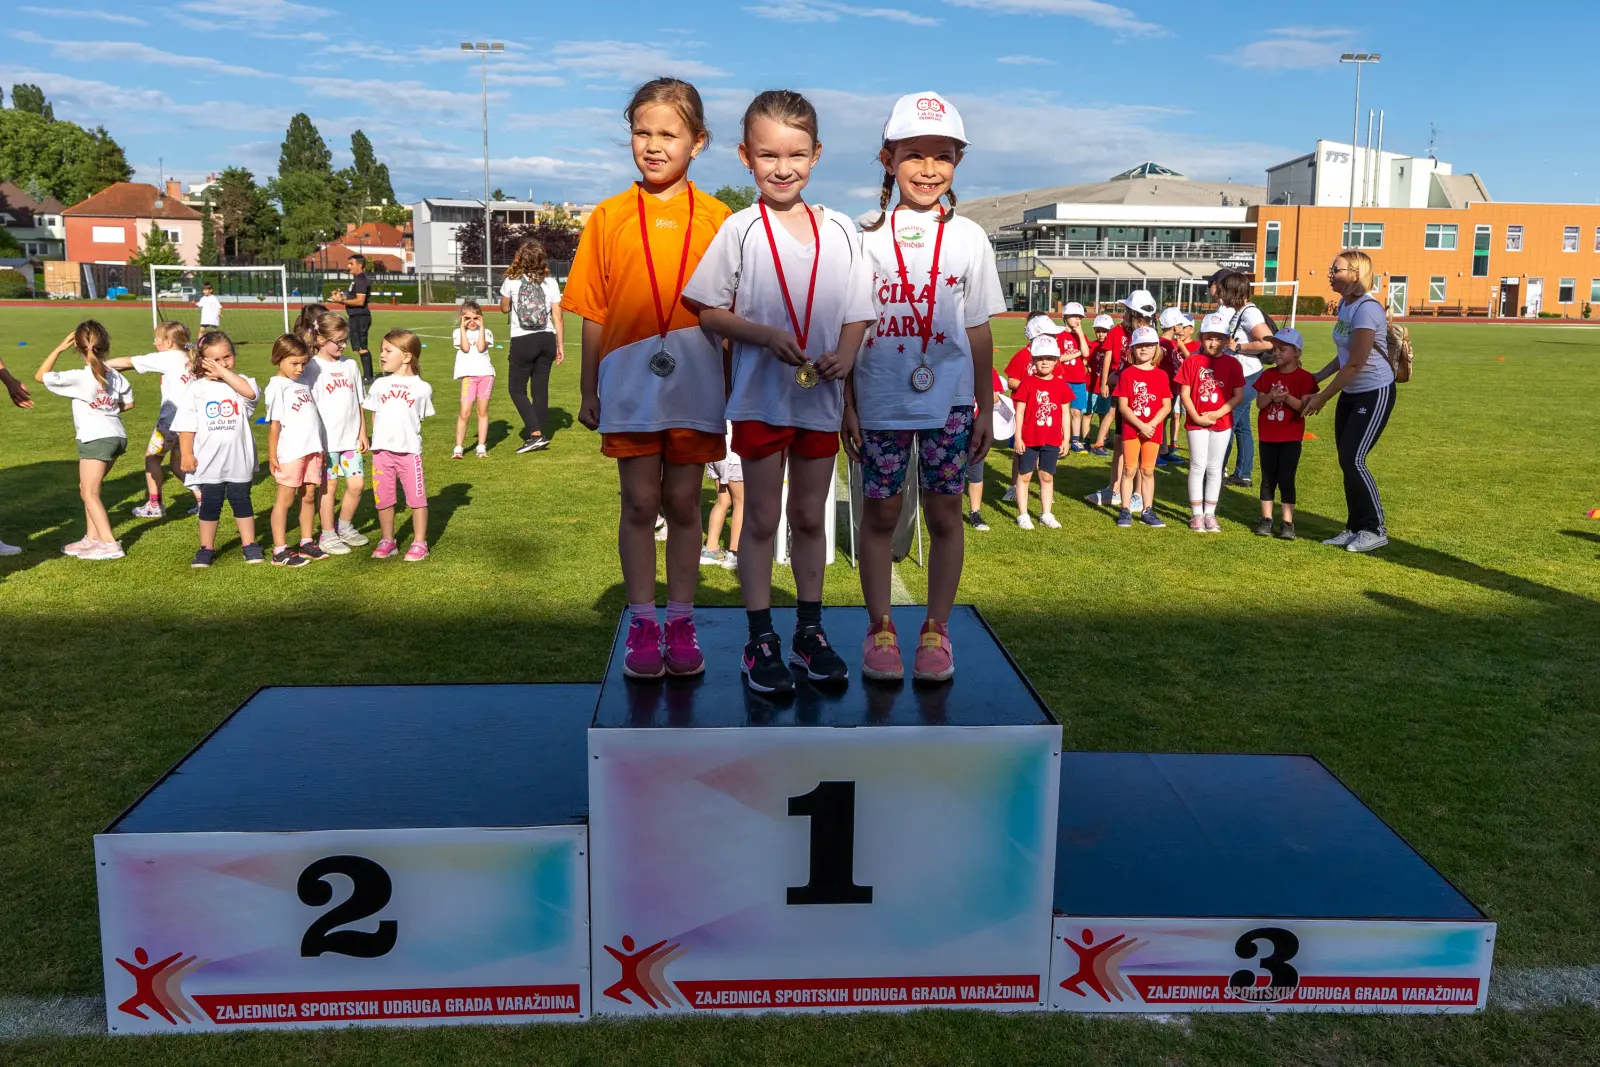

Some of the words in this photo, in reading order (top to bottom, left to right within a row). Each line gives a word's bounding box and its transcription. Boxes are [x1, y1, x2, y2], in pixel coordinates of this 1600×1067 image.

[1325, 151, 1350, 164] TTS
[878, 279, 936, 305] ČIRA
[877, 311, 933, 337] ČARA
[326, 379, 355, 394] BAJKA
[381, 390, 415, 408] BAJKA
[786, 781, 873, 905] 1
[297, 855, 399, 959] 2
[1228, 927, 1300, 1003] 3
[695, 990, 771, 1005] ZAJEDNICA
[775, 989, 849, 1003] SPORTSKIH
[853, 987, 907, 1001] UDRUGA
[911, 986, 957, 1000] GRADA
[960, 983, 1035, 999] VARAŽDINA
[1146, 985, 1220, 1000] ZAJEDNICA
[1223, 985, 1296, 1000] SPORTSKIH
[1298, 986, 1351, 1000] UDRUGA
[1354, 986, 1398, 1001] GRADA
[1401, 984, 1474, 1001] VARAŽDINA
[215, 1003, 297, 1020] ZAJEDNICA
[300, 1001, 379, 1017] SPORTSKIH
[383, 998, 442, 1014] UDRUGA
[445, 996, 493, 1013] GRADA
[496, 993, 575, 1011] VARAŽDINA
